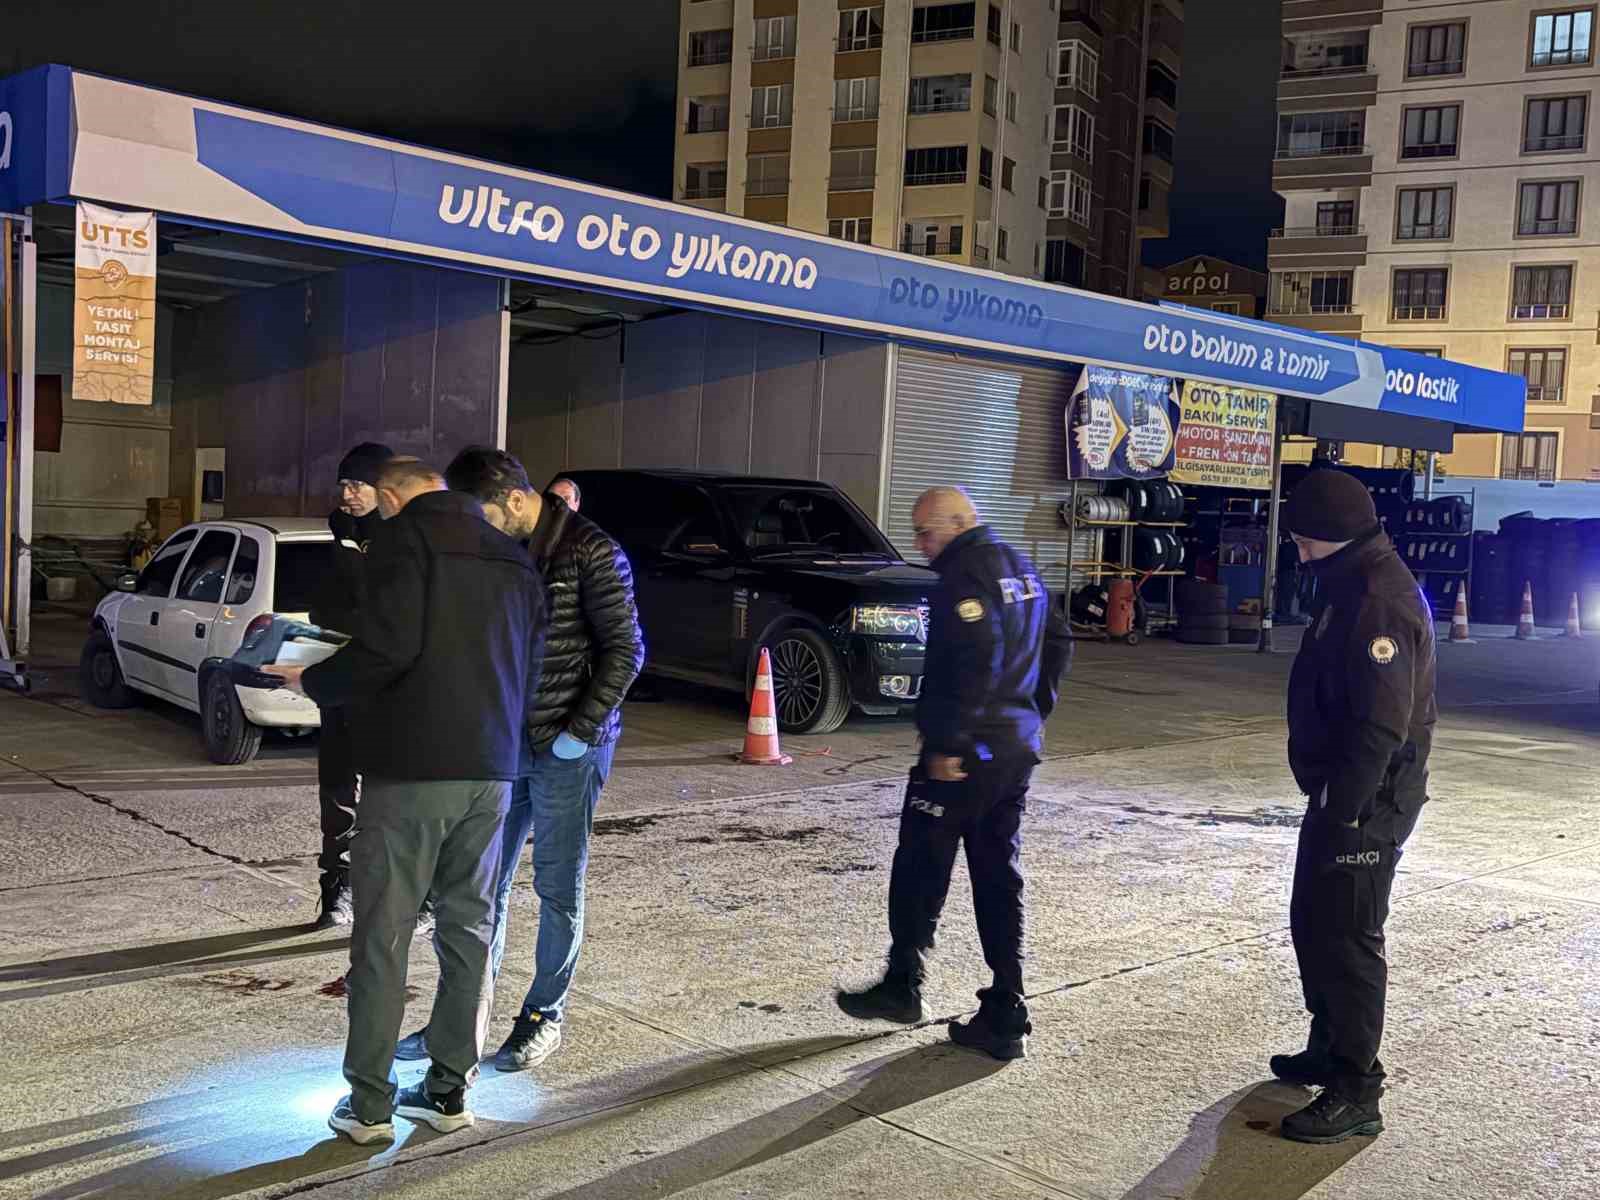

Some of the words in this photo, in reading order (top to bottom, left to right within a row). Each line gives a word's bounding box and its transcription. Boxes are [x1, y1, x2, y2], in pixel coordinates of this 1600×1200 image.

[438, 184, 565, 243] ultra
[576, 213, 661, 261] oto
[81, 222, 149, 249] UTTS
[889, 277, 939, 309] oto
[1168, 272, 1229, 295] arpol
[84, 334, 141, 350] MONTAJ
[1143, 324, 1187, 355] oto
[1260, 348, 1274, 372] &
[1278, 347, 1330, 381] tamir
[1190, 388, 1221, 406] OTO
[1386, 368, 1415, 395] oto
[1415, 372, 1460, 404] lastik
[1184, 408, 1223, 425] BAKIM
[1181, 426, 1220, 441] MOTOR
[1188, 445, 1220, 460] FREN
